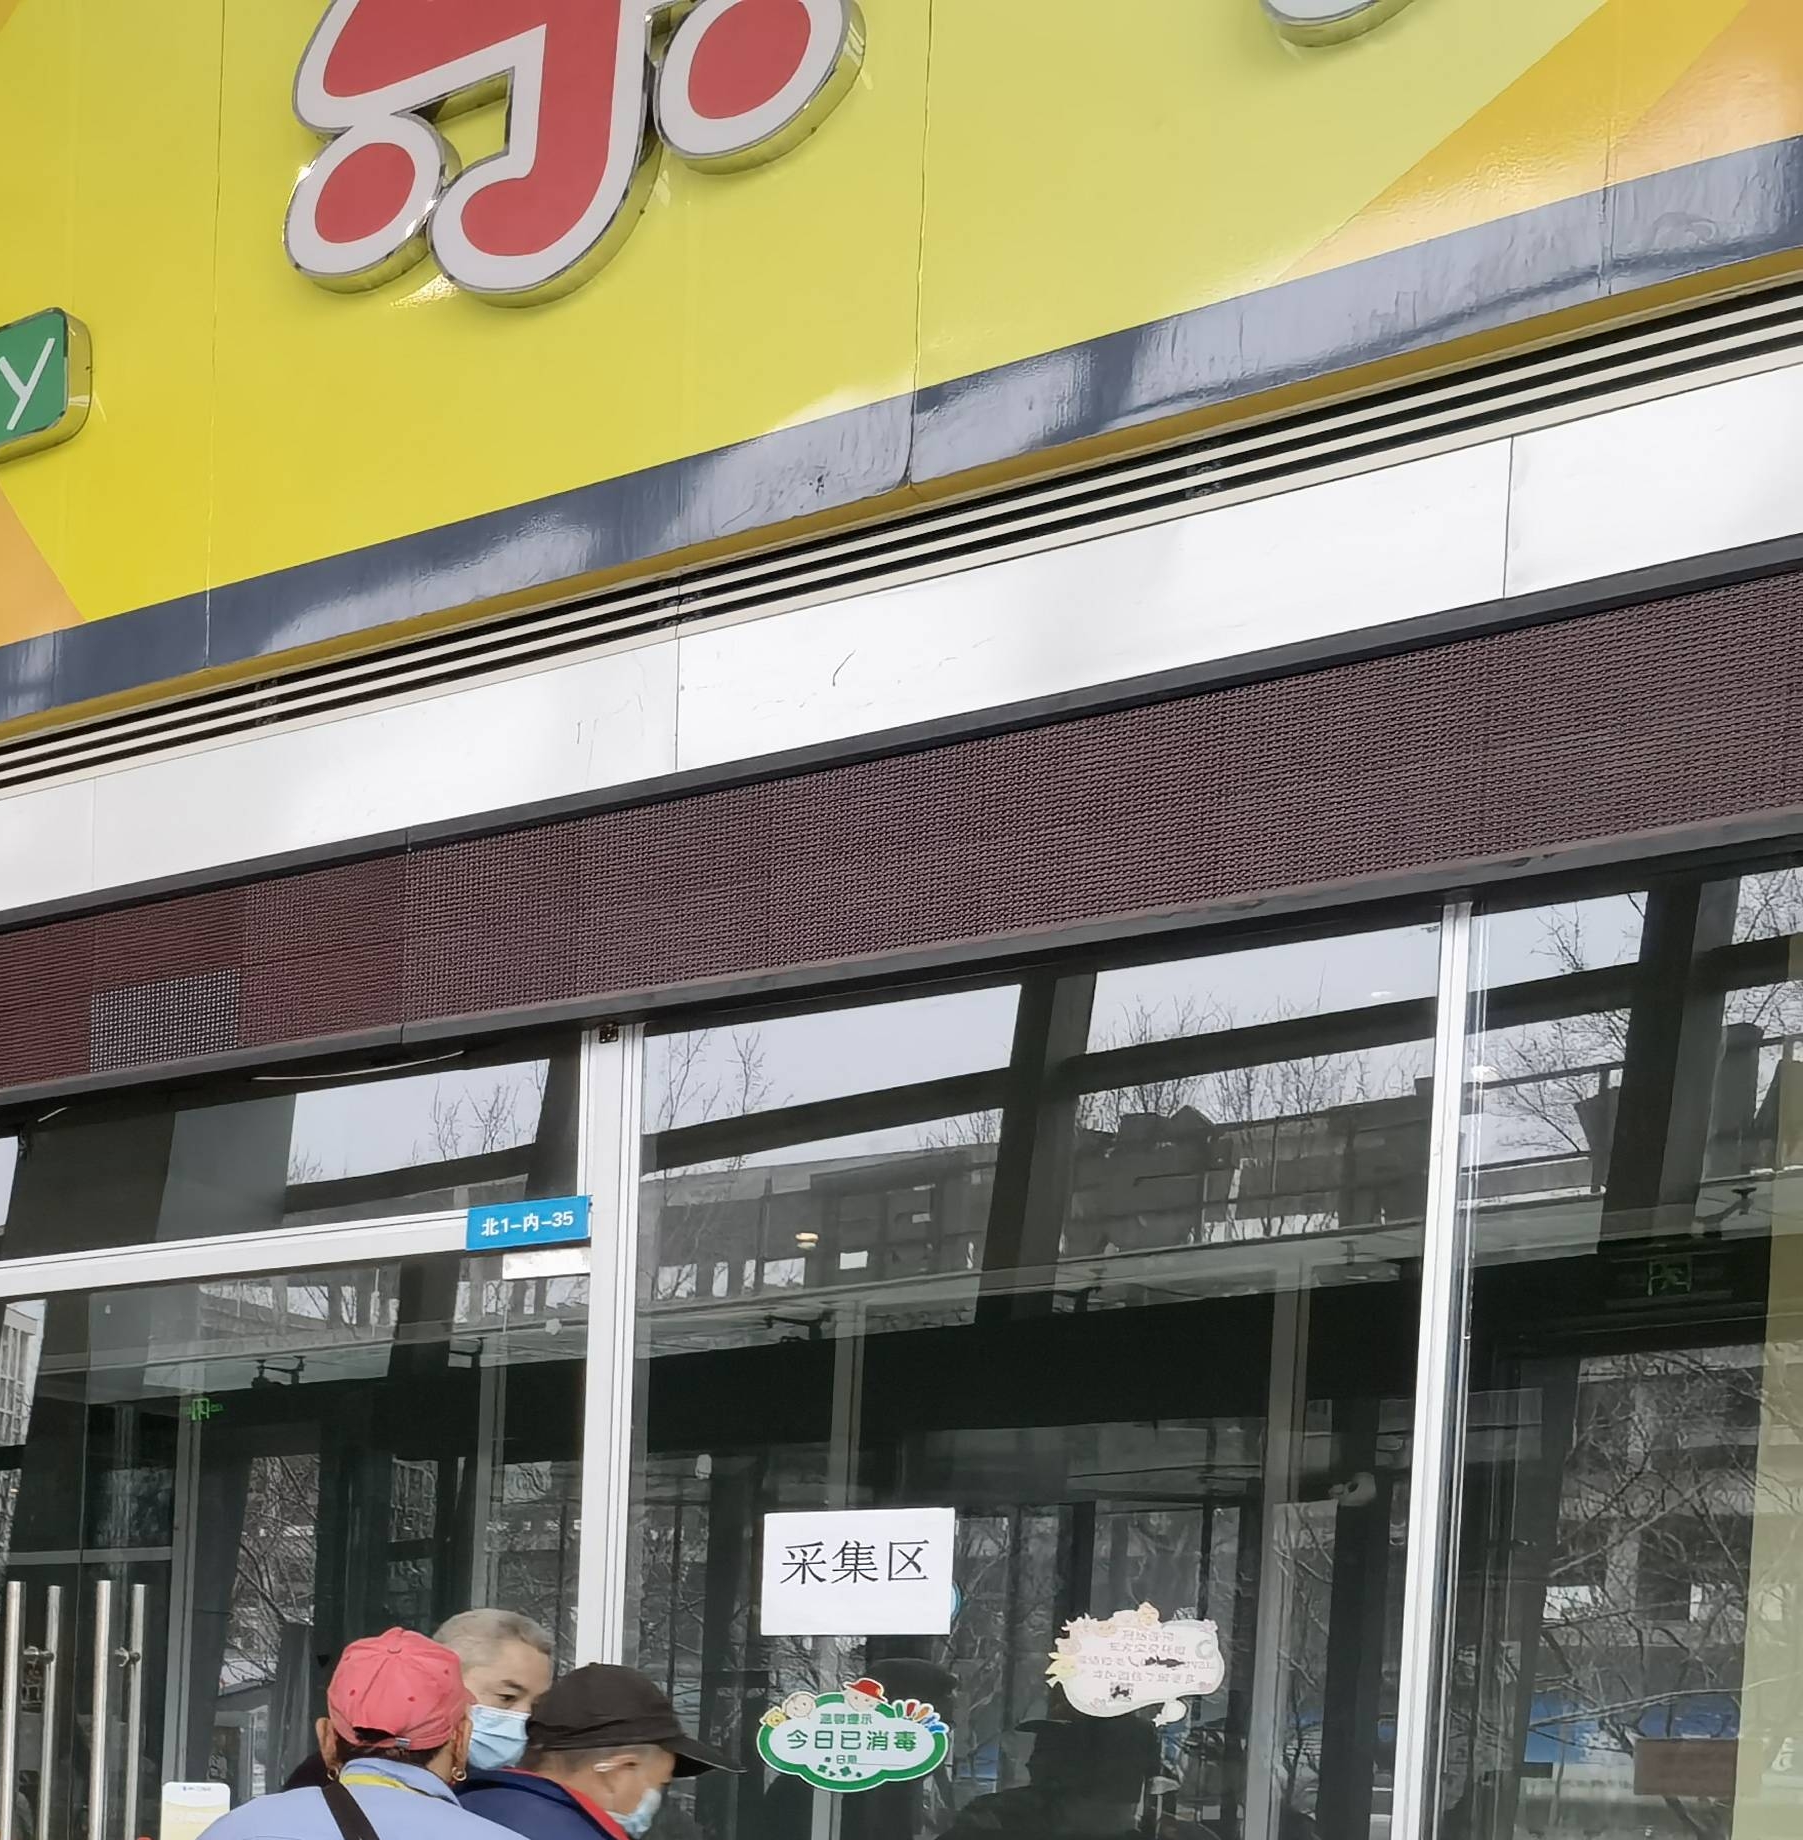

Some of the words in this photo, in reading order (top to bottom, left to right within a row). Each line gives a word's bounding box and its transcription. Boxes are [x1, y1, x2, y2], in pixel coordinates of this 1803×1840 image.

[480, 1210, 574, 1237] 北1-内-35
[780, 1539, 930, 1585] 采集区
[786, 1730, 918, 1752] 今日已消毒
